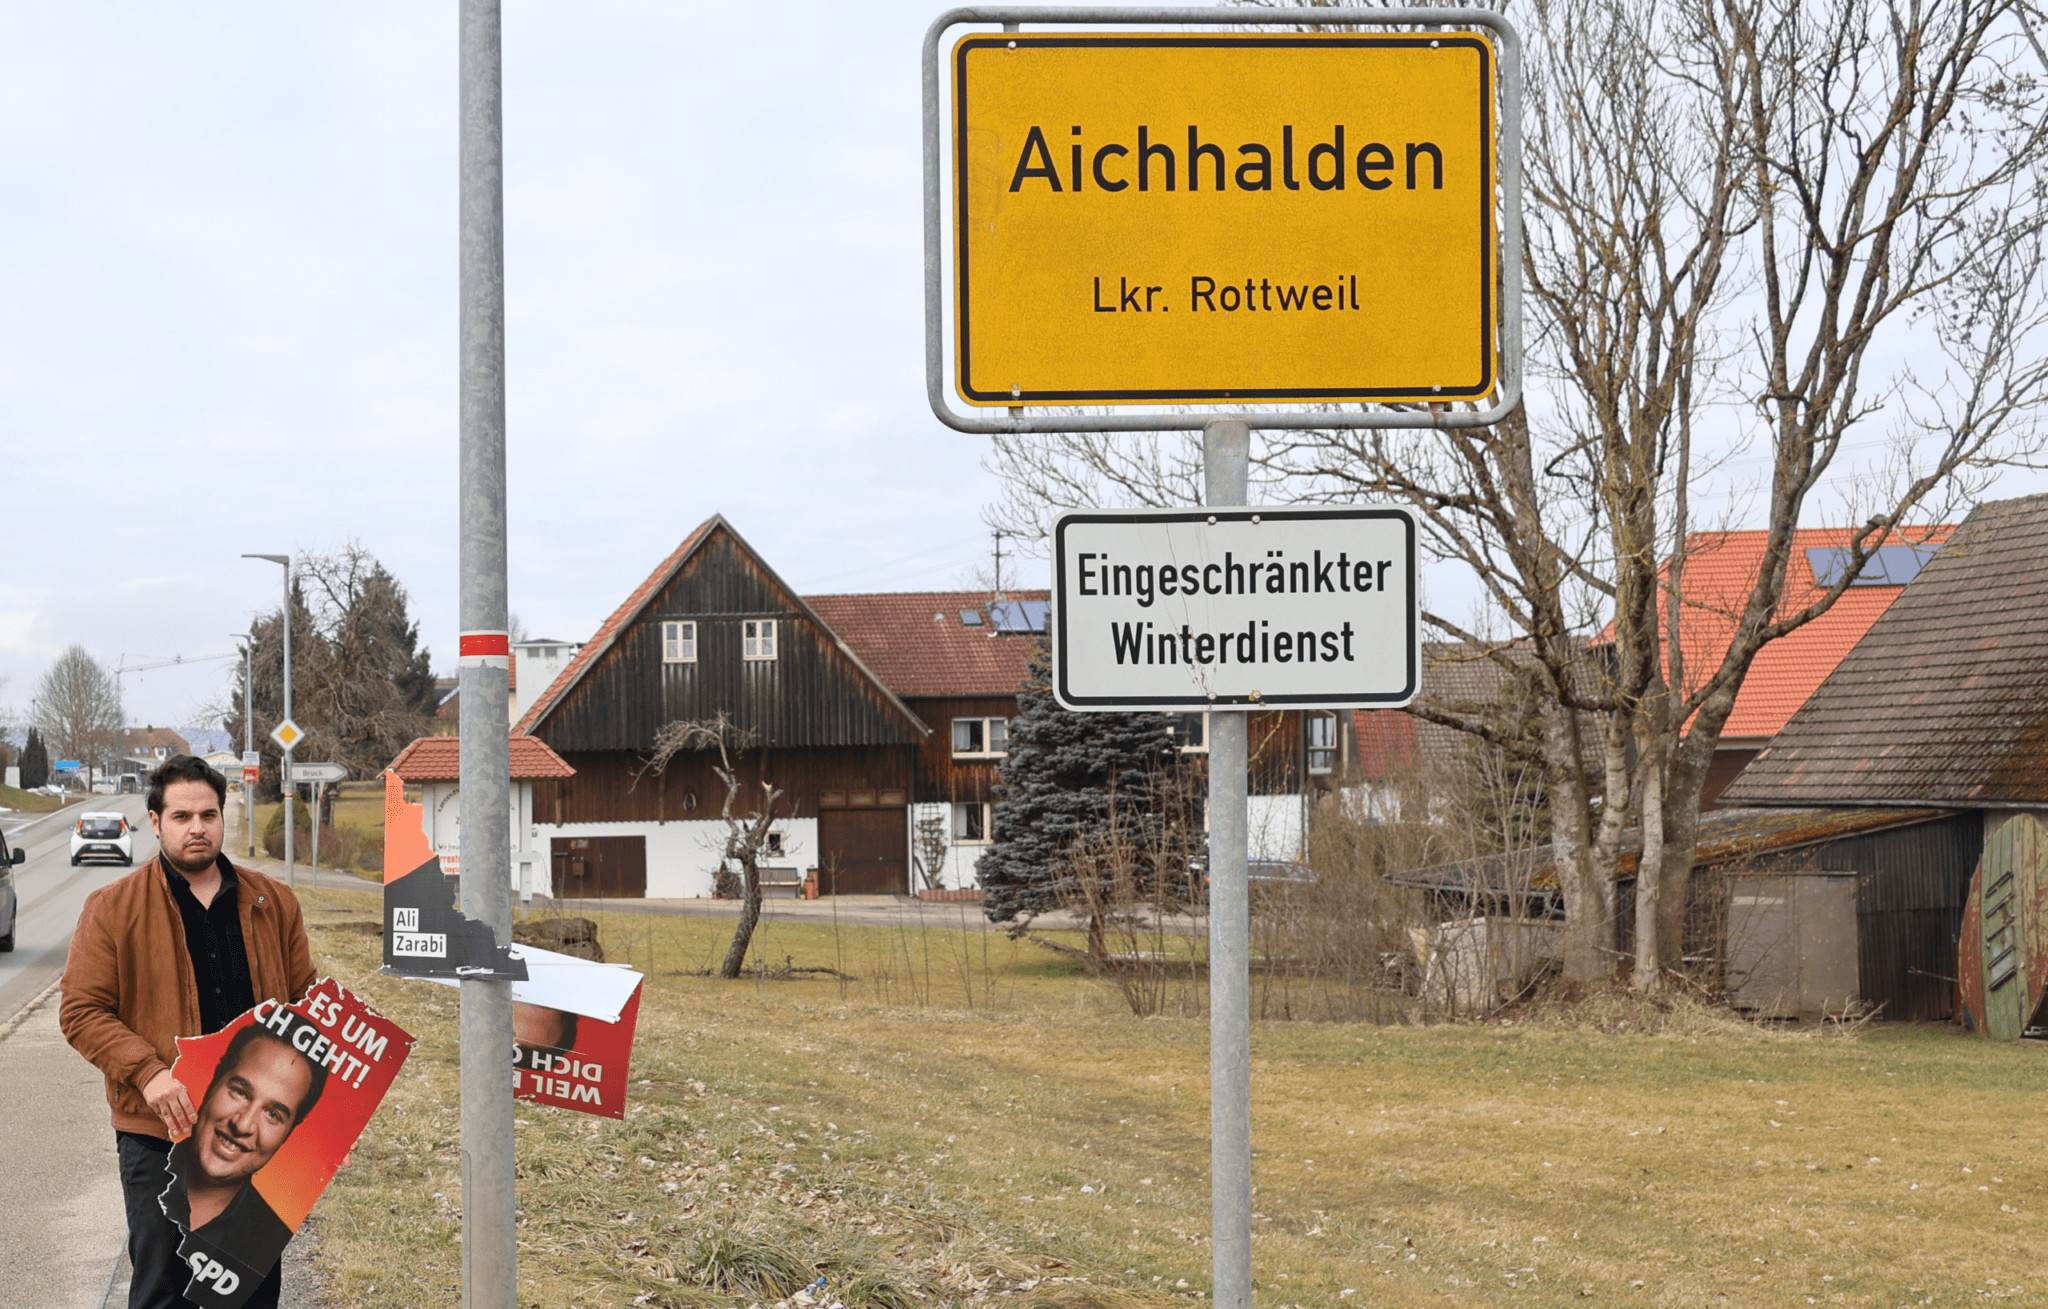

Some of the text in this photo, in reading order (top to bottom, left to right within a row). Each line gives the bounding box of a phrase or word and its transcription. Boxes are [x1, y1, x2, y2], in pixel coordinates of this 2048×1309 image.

[1008, 124, 1443, 193] Aichhalden
[1093, 274, 1360, 313] Lkr. Rottweil
[1078, 549, 1392, 608] Eingeschränkter
[1111, 620, 1355, 665] Winterdienst
[303, 769, 323, 777] Bruck
[396, 910, 416, 927] Ali
[396, 935, 443, 953] Zarabi
[253, 1000, 371, 1089] CH GEHT!
[307, 991, 389, 1063] ES UM
[531, 1050, 603, 1082] DICH
[530, 1073, 602, 1105] WEIL
[189, 1251, 240, 1296] SPD
